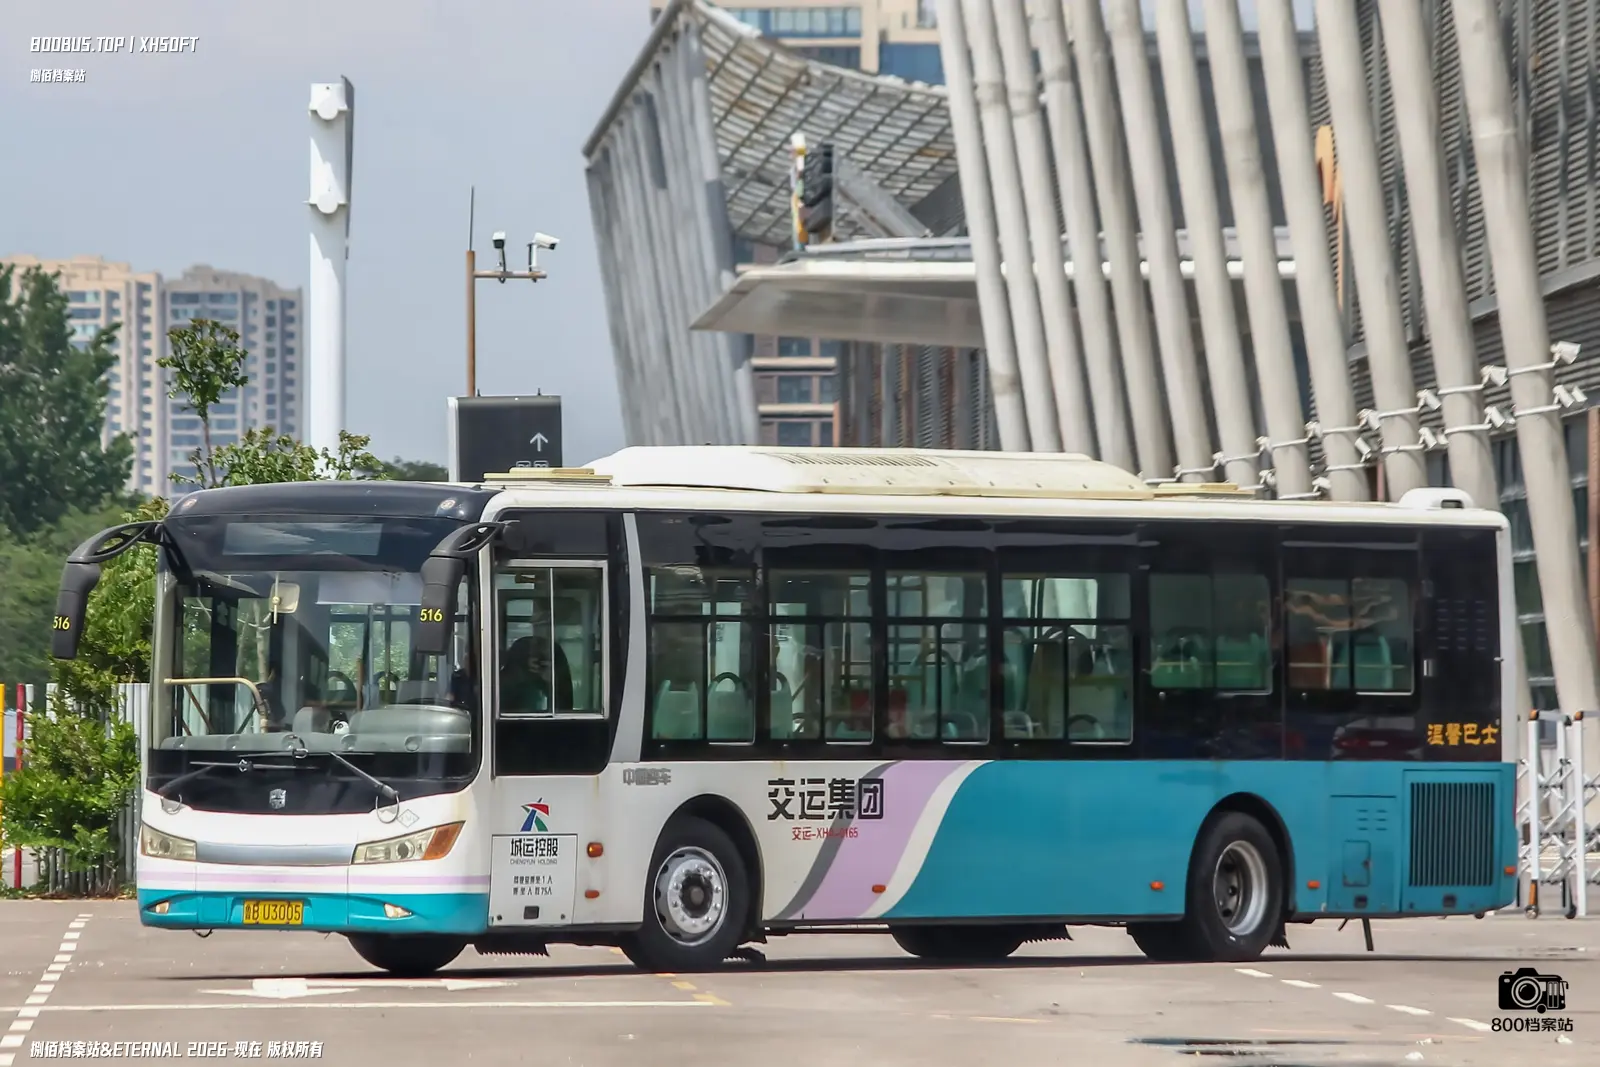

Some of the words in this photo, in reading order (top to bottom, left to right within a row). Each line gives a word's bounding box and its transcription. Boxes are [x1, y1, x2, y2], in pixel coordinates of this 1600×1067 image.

[52, 615, 71, 630] 516
[420, 608, 443, 622] 516
[767, 777, 884, 820] 交运集团
[510, 837, 559, 857] 城运控股
